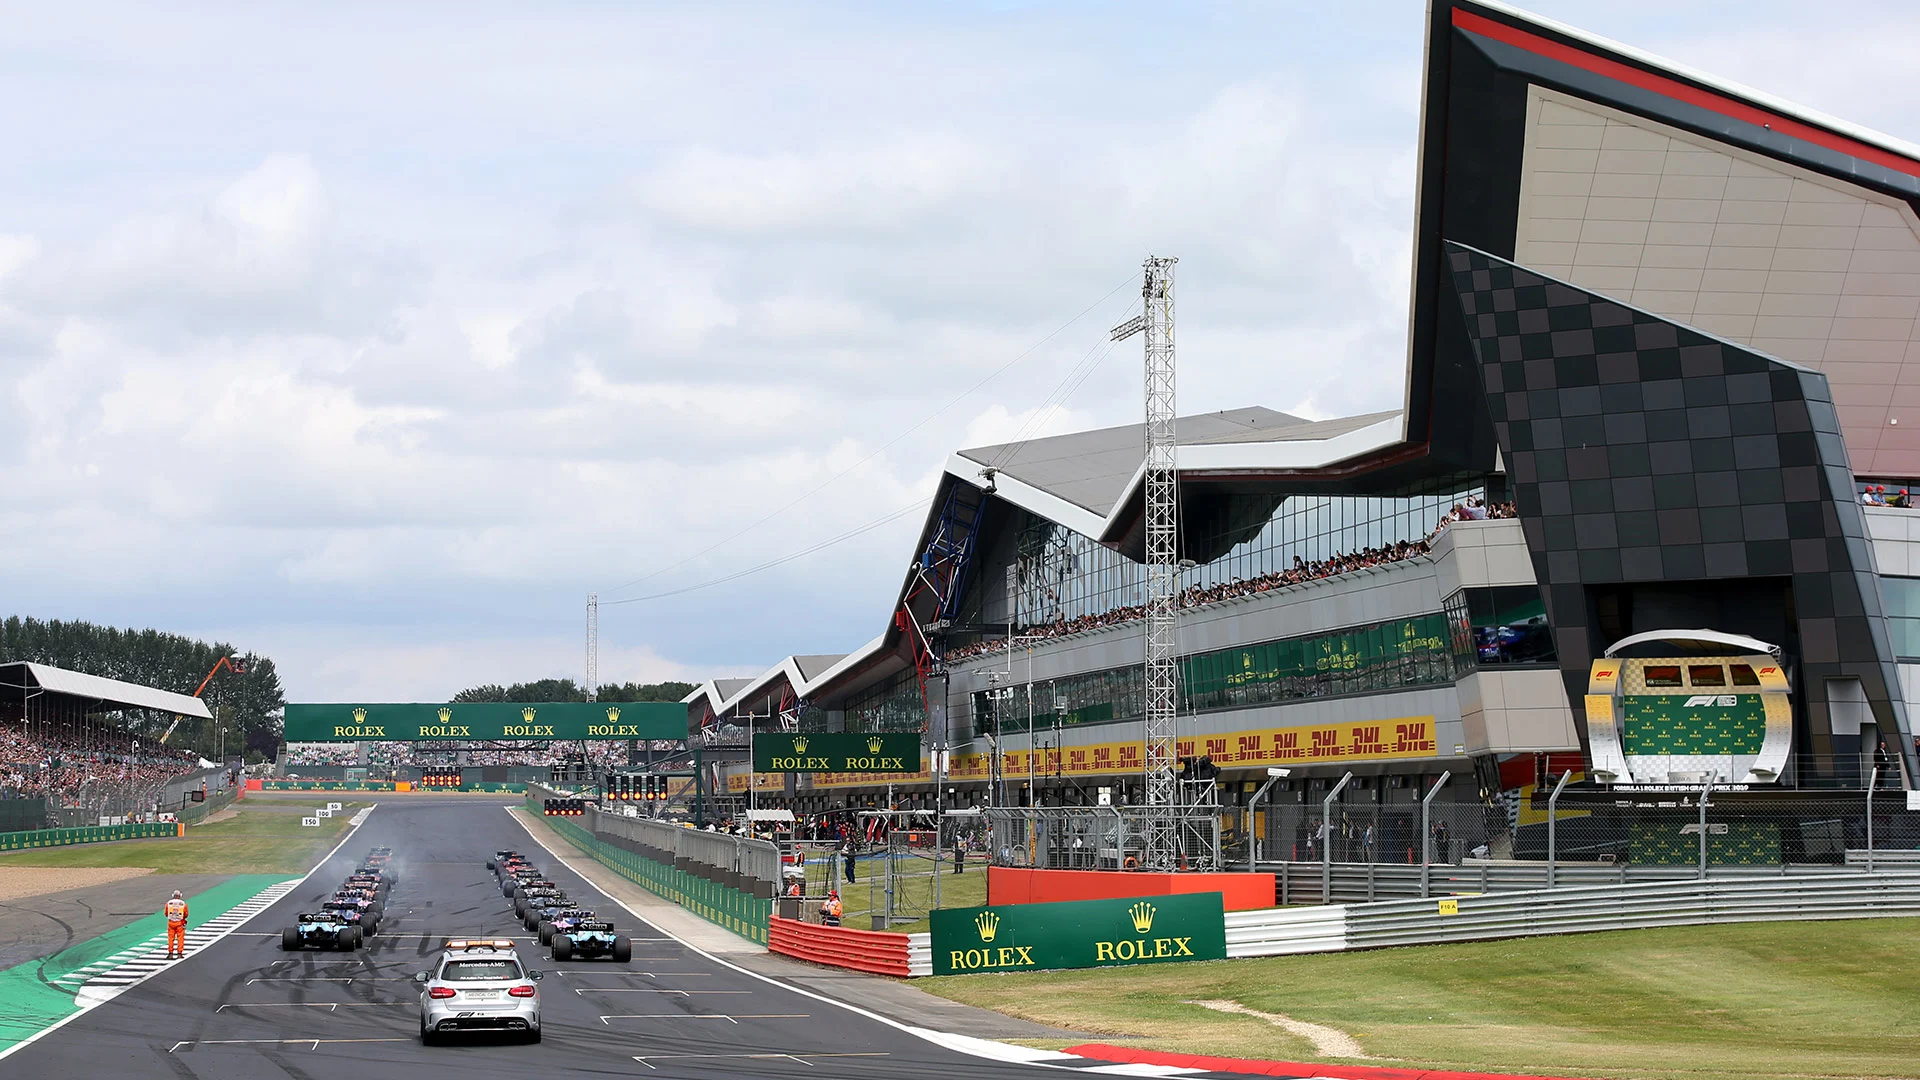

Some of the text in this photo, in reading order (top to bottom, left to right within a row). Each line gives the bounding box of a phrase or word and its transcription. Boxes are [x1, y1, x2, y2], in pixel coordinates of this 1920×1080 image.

[334, 725, 639, 737] ROLEX ROLEX ROLEX ROLEX
[1238, 736, 1263, 761] DHL
[1273, 733, 1301, 758] DHL
[1311, 730, 1340, 757] DHL
[1351, 726, 1383, 755] DHL
[1395, 723, 1430, 752] DHL
[771, 757, 904, 769] ROLEX ROLEX
[950, 937, 1194, 970] ROLEX ROLEX
